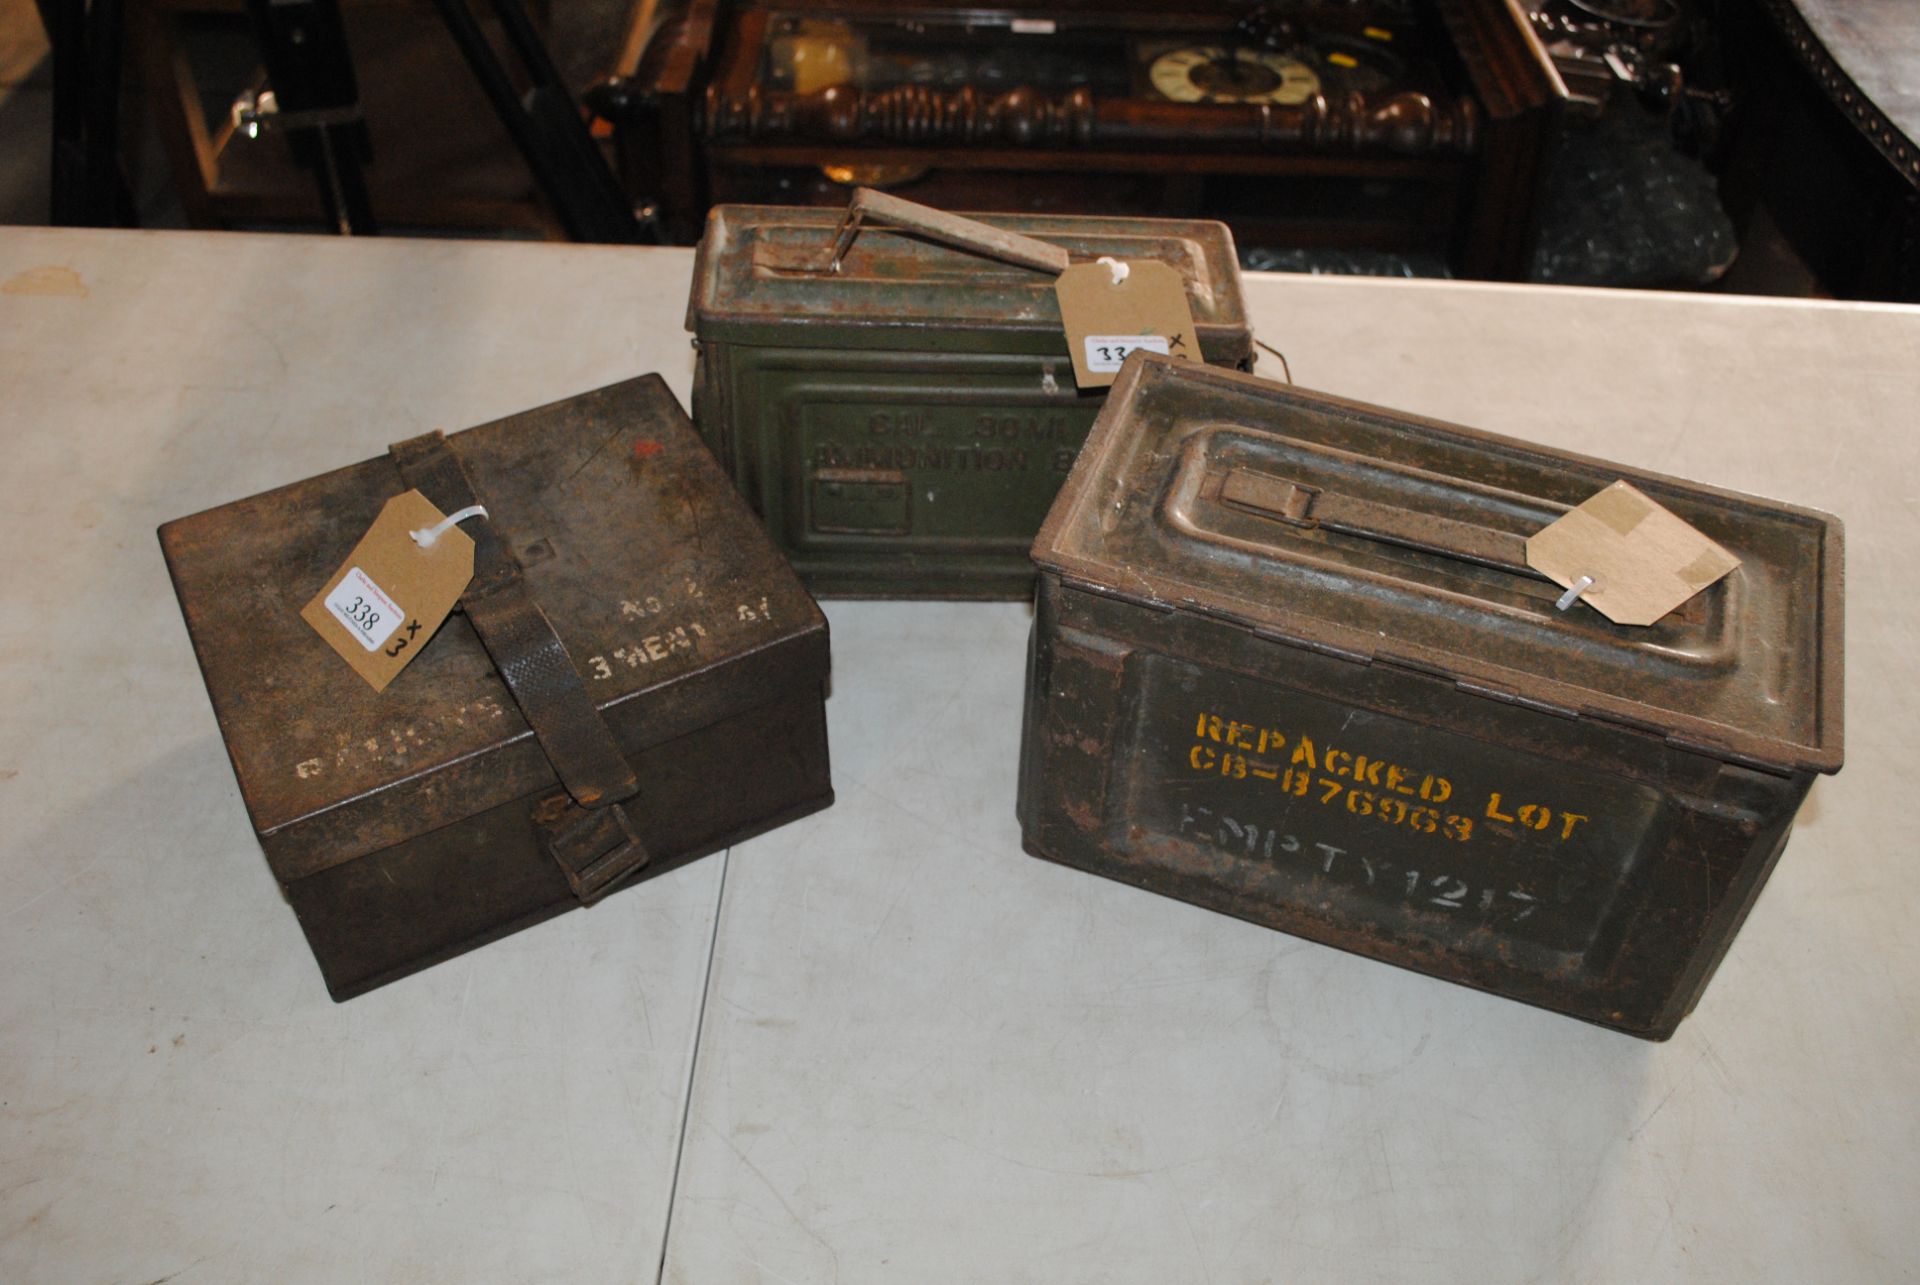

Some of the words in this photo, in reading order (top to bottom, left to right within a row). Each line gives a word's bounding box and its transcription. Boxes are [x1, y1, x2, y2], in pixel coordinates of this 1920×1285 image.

[1096, 346, 1128, 362] 33
[345, 596, 380, 631] 338
[1195, 711, 1453, 804] REPACKED
[1485, 791, 1591, 841] LOT
[1179, 801, 1393, 885] EMPTY
